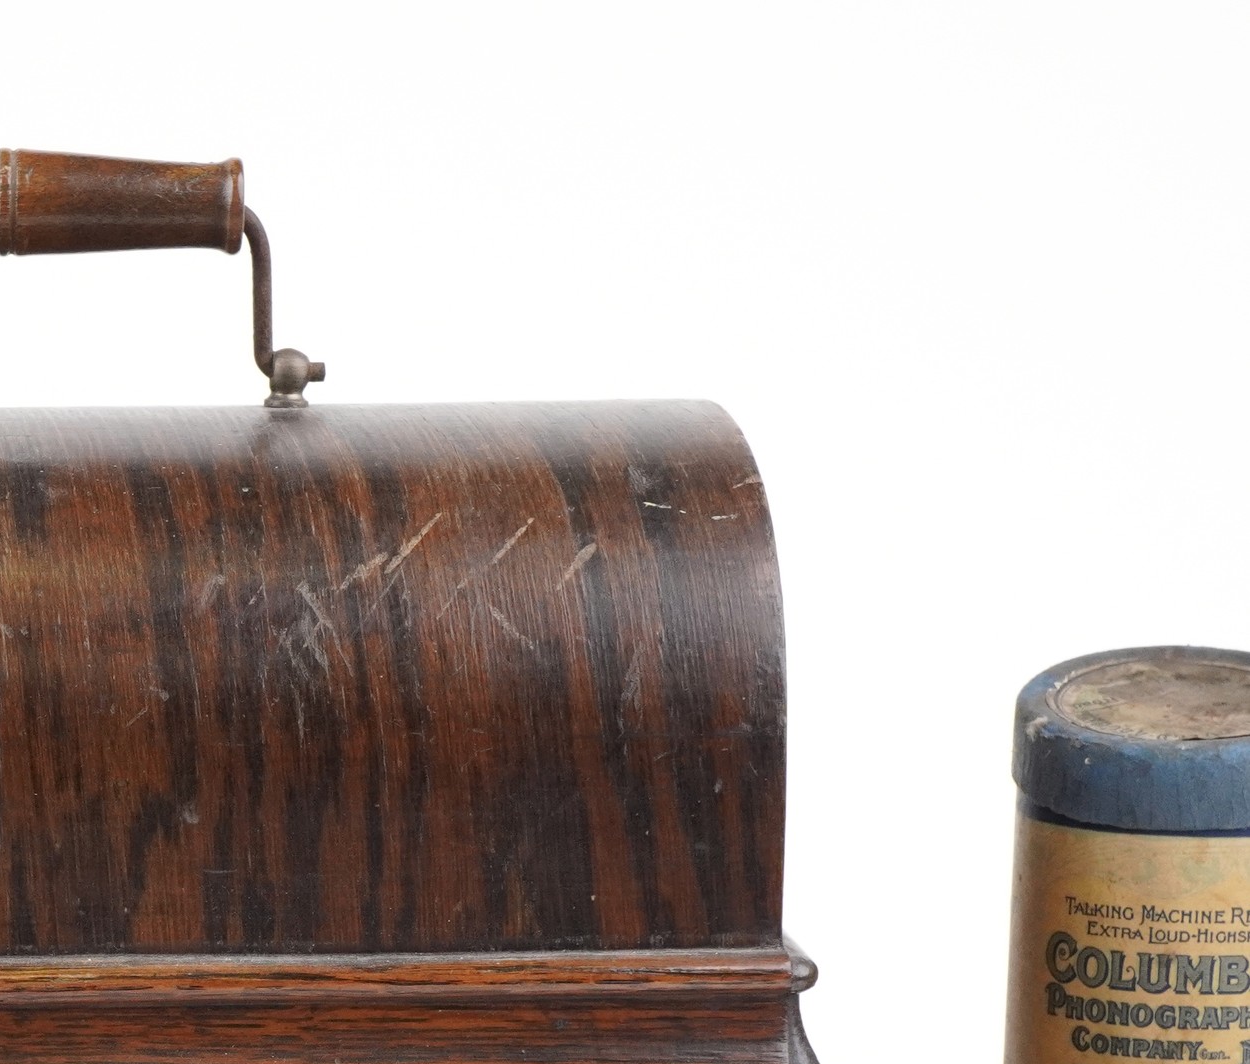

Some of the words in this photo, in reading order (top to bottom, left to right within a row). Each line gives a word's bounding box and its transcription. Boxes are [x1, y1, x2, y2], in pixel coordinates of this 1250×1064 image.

[1065, 896, 1135, 922] TALKING
[1140, 905, 1226, 925] MACHINE
[1087, 921, 1144, 941] EXTRA
[1148, 927, 1250, 944] LOUD-HIGHS
[1046, 931, 1250, 995] COLUMB
[1071, 1025, 1203, 1061] COMPANY
